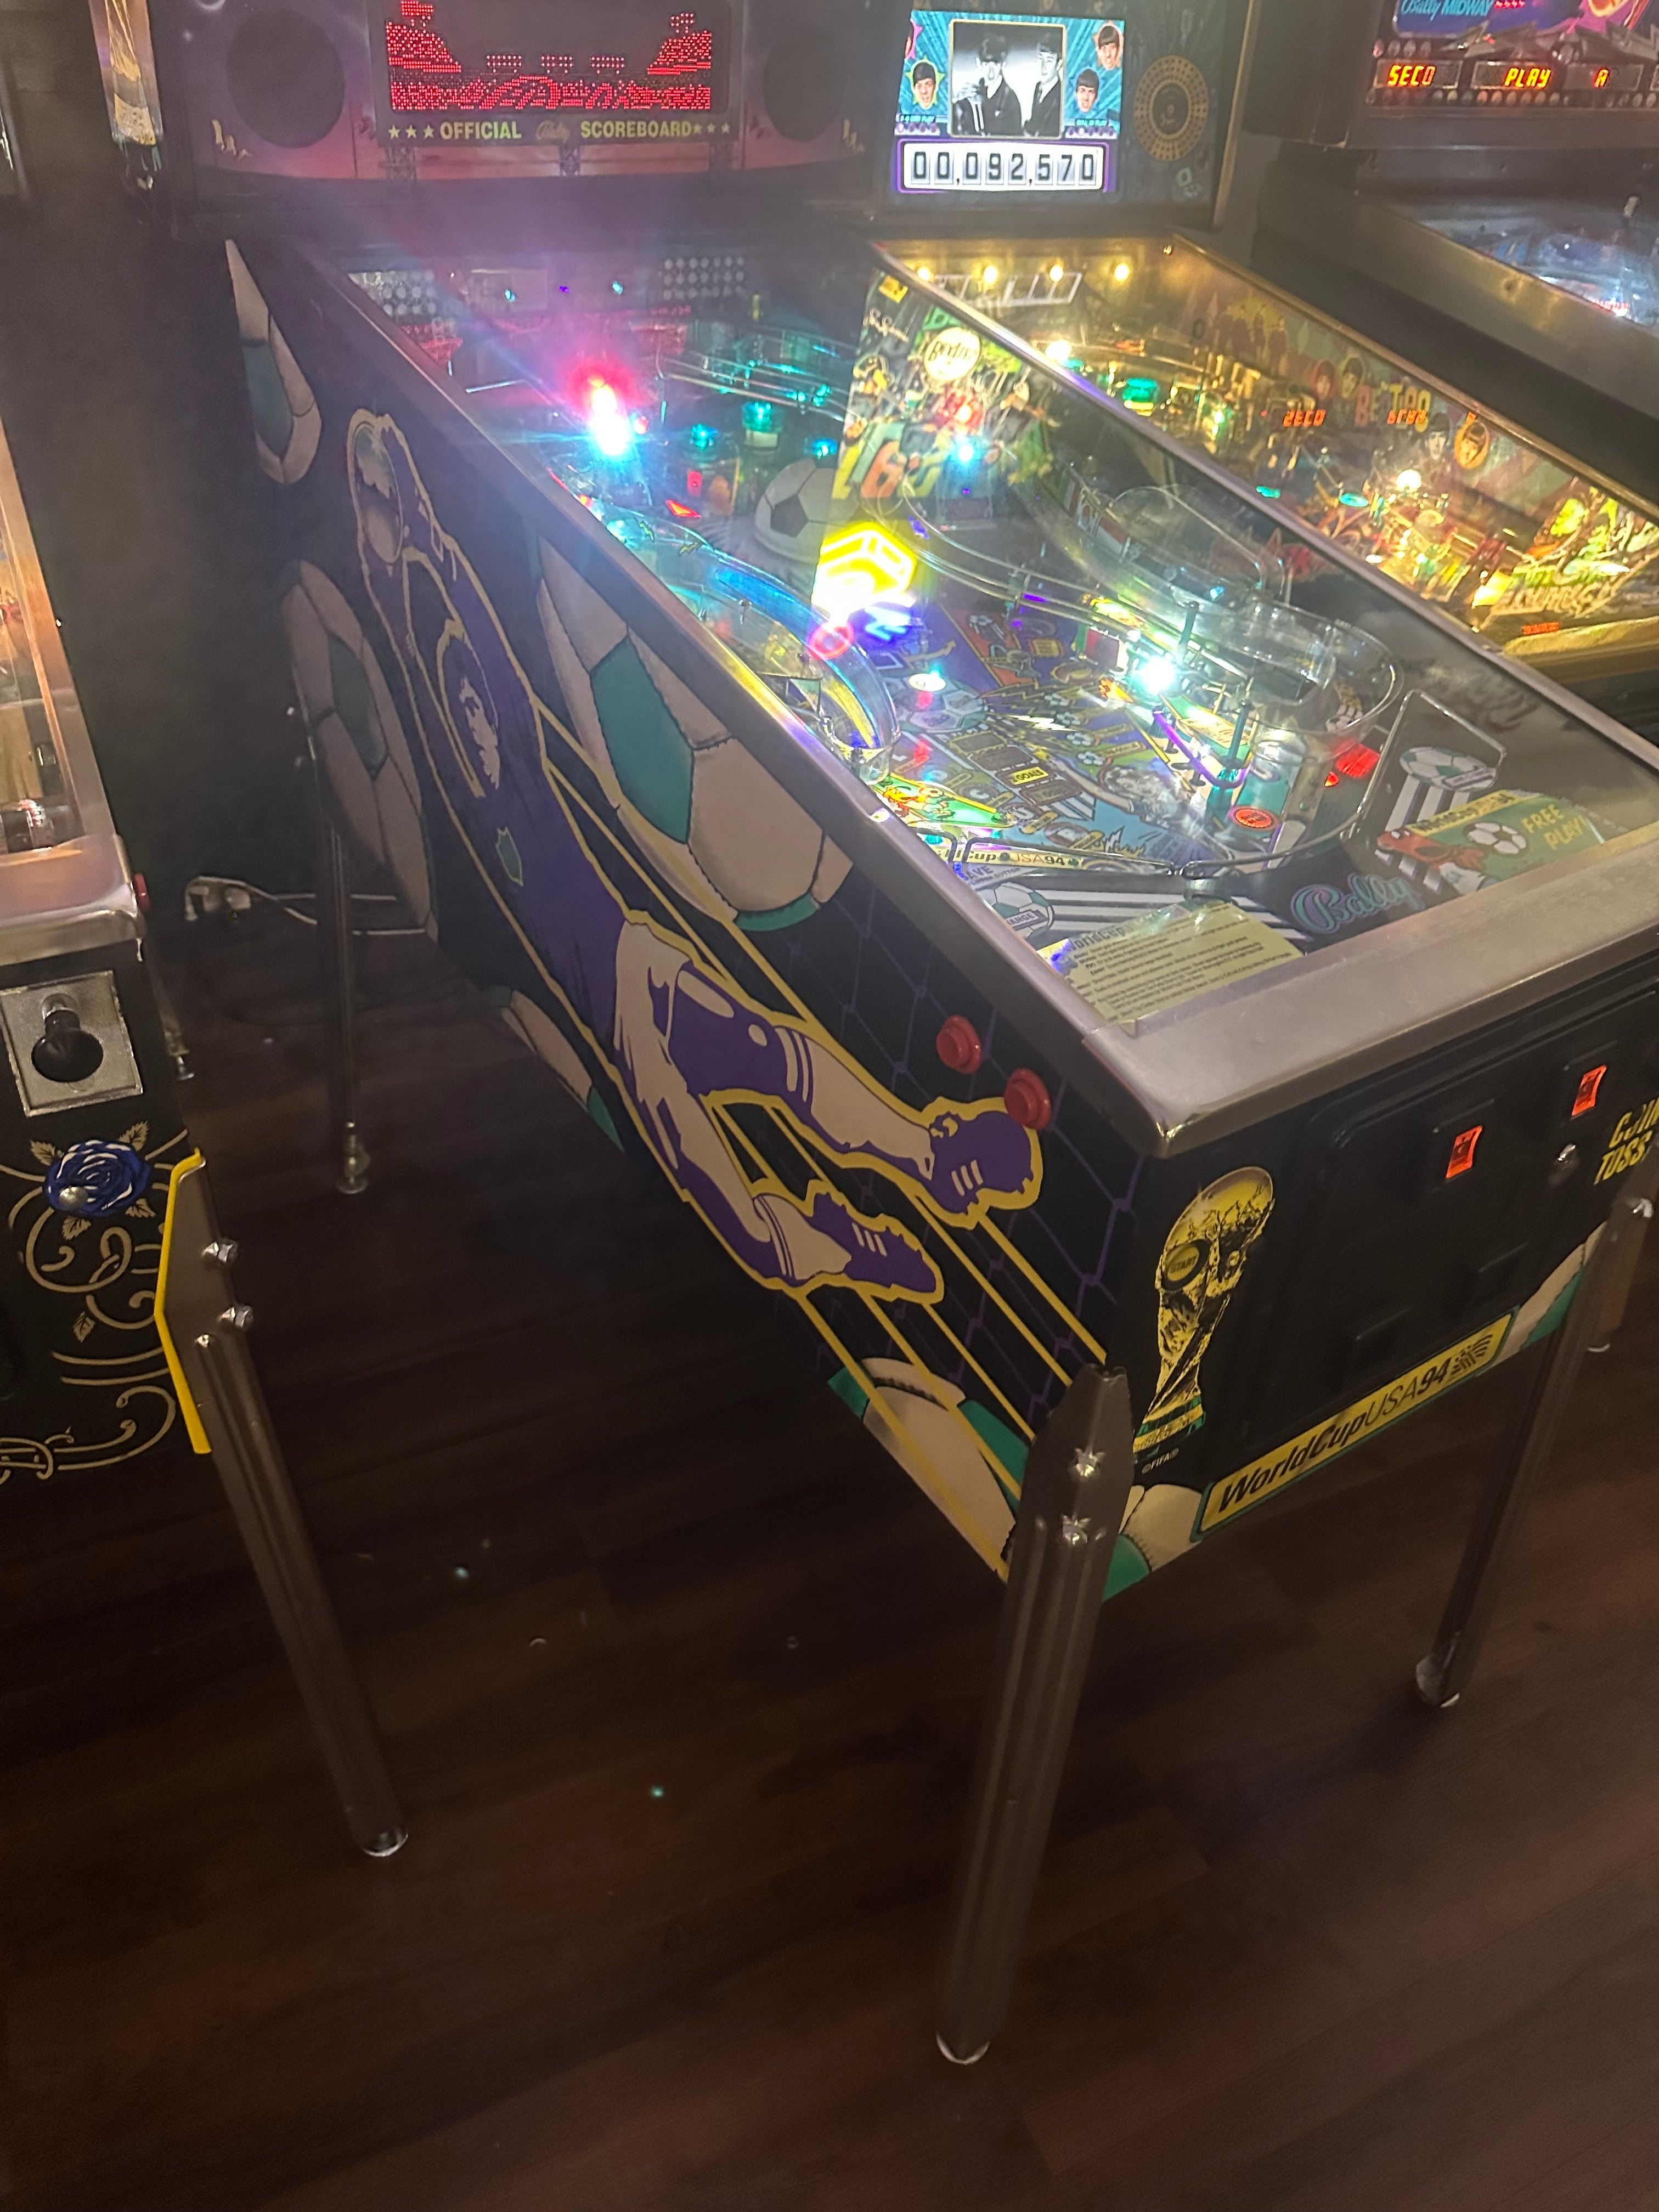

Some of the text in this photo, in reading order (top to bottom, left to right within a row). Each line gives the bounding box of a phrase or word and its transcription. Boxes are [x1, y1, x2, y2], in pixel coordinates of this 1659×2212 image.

[1504, 67, 1552, 88] PLAY
[439, 121, 522, 140] OFFICIAL
[580, 120, 692, 138] SCOREBOARD
[913, 151, 1094, 185] 00,092,570
[1520, 804, 1565, 834] FREE
[1290, 873, 1426, 934] Bally
[1006, 912, 1035, 926] ANGE
